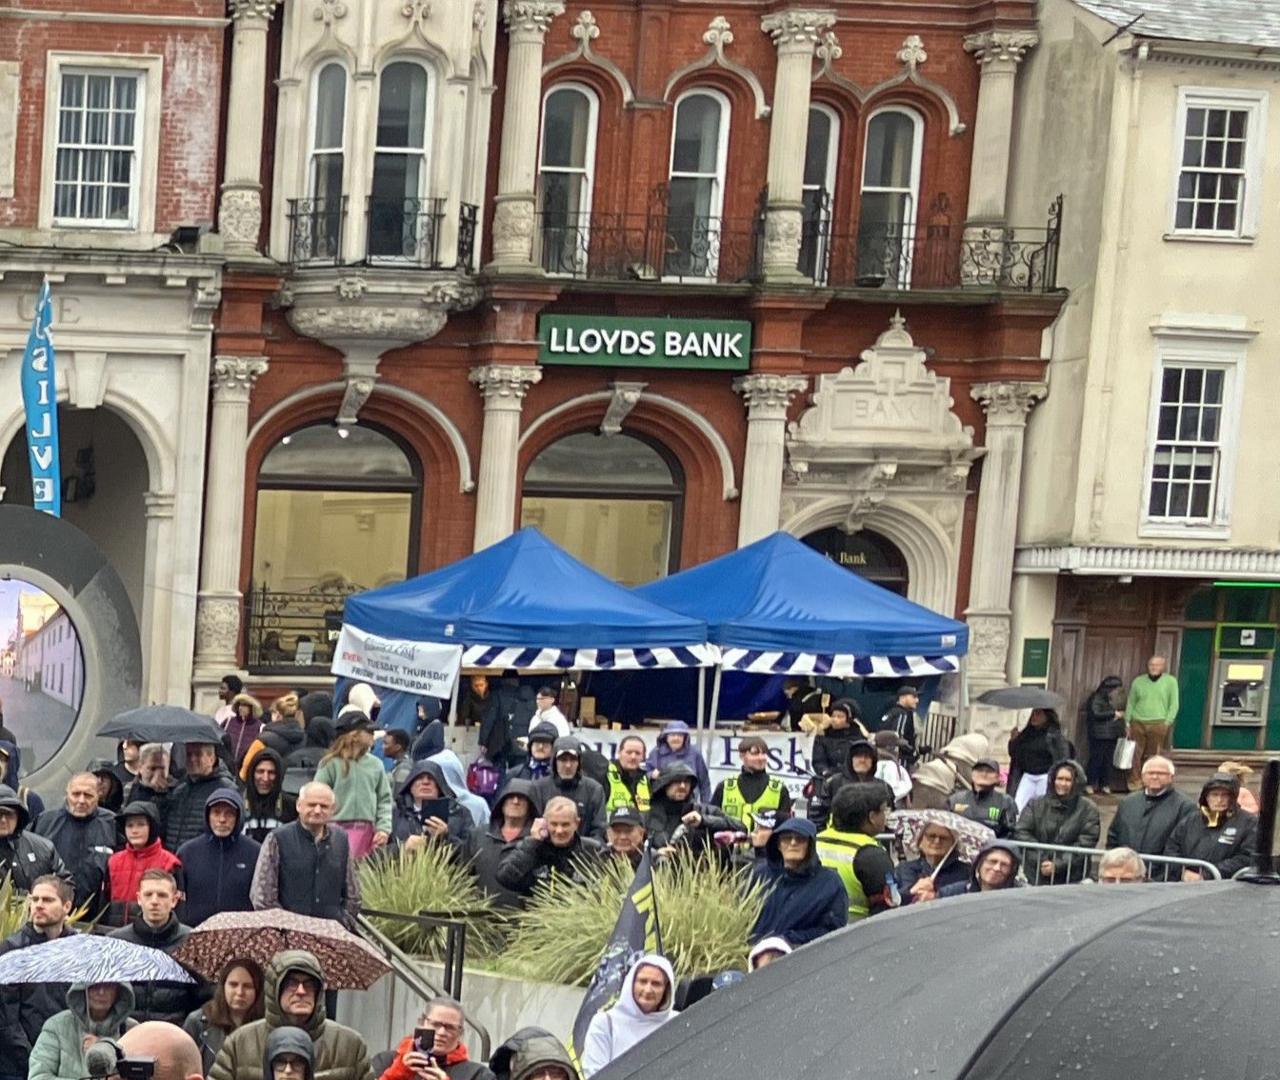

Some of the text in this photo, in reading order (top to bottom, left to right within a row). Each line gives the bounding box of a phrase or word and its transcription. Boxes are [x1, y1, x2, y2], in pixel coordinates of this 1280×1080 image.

[549, 327, 744, 359] LLOYDS BANK
[854, 400, 919, 422] BANK
[840, 551, 867, 564] Bank
[402, 666, 449, 681] THURSDAY
[720, 736, 814, 777] Fsh
